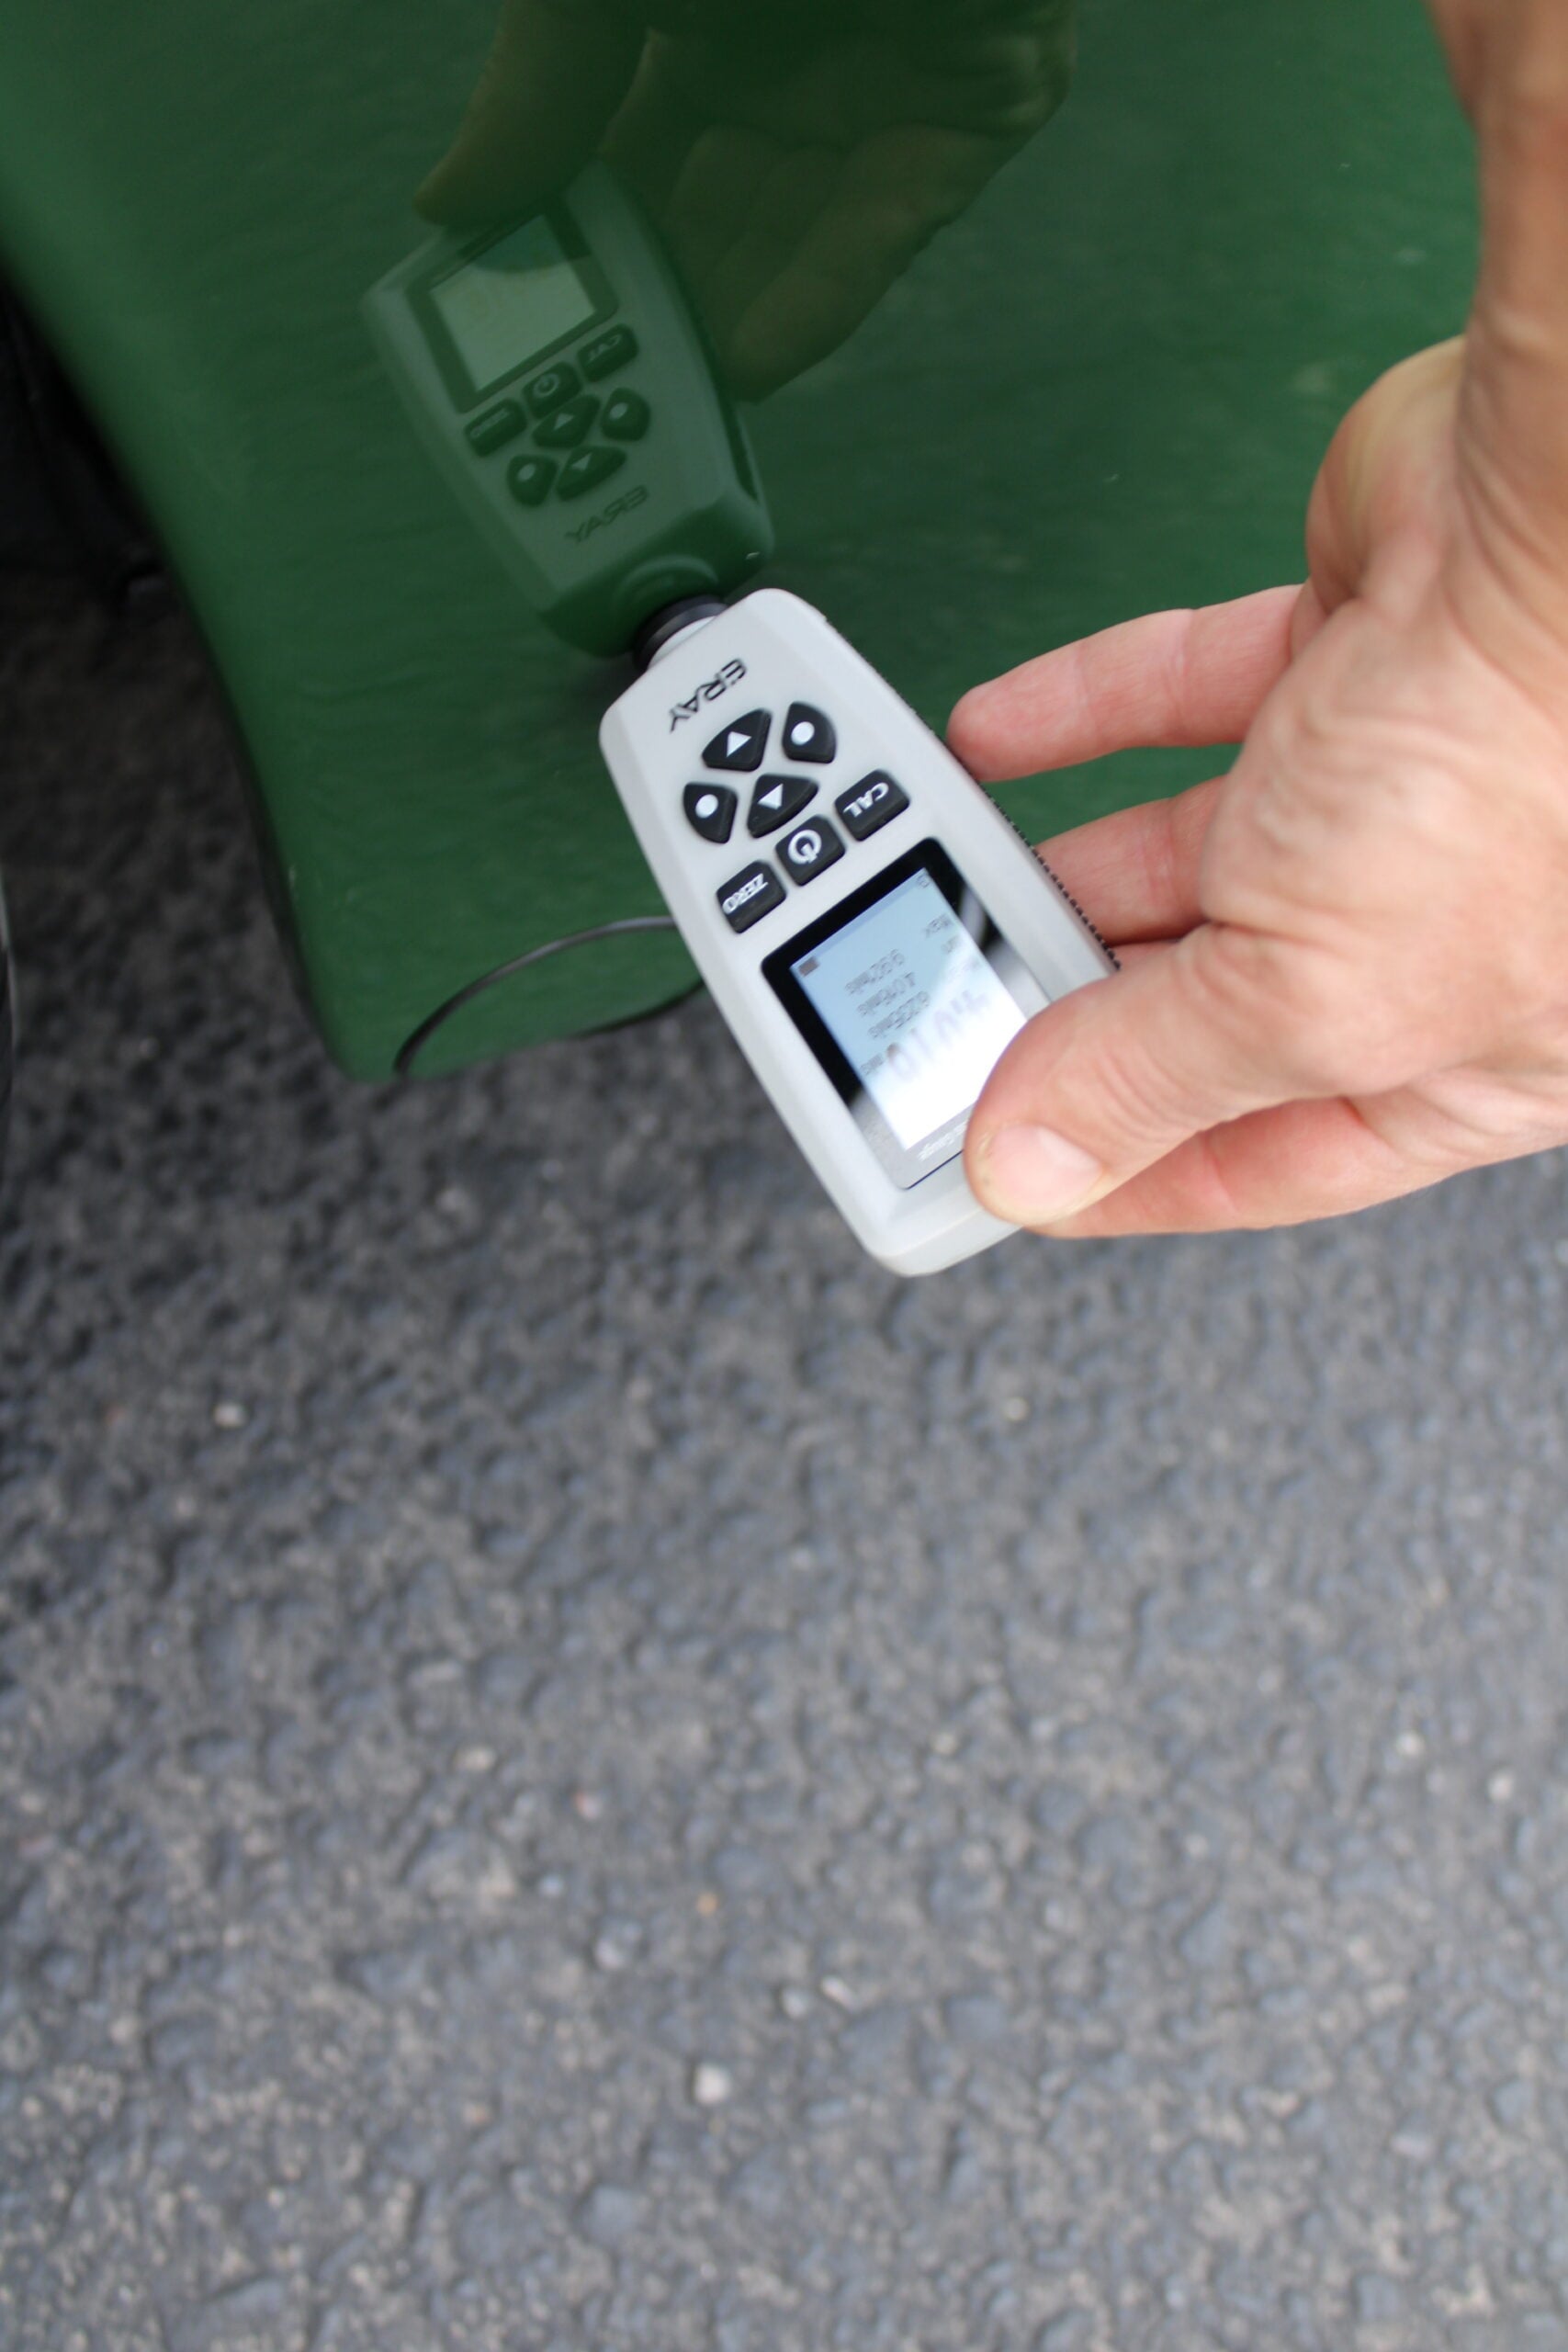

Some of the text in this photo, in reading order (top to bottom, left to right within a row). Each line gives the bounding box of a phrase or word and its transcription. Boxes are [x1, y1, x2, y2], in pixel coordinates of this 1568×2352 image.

[669, 657, 747, 733] ERAY
[842, 781, 889, 818] CAL
[722, 872, 769, 915] ZERO
